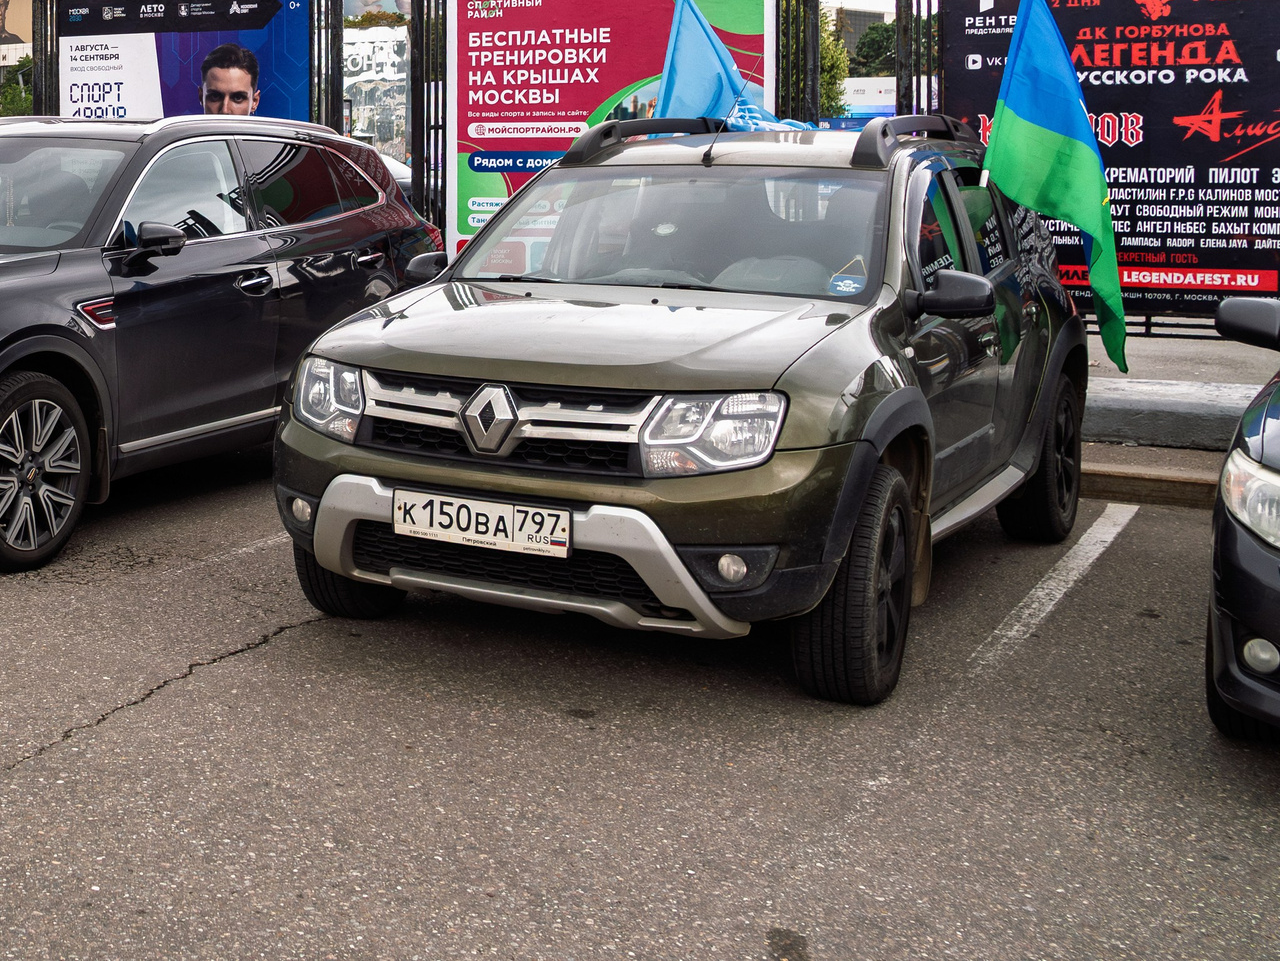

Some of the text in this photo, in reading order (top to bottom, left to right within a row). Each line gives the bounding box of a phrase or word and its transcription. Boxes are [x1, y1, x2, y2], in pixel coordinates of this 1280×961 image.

[140, 4, 165, 13] ЛЕТО
[289, 1, 300, 9] 0+
[468, 8, 503, 19] РАЙОН
[965, 15, 1017, 27] РЕН ТВ
[468, 27, 611, 48] БЕСПЛАТНЫЕ
[1076, 23, 1230, 40] ДК ГОРБУНОВА
[75, 44, 109, 52] АВГУСТА
[1070, 39, 1243, 67] ЛЕГЕНДА
[468, 47, 607, 66] ТРЕНИРОВКИ
[986, 57, 1002, 66] VK
[86, 64, 123, 72] СВОБОДНЫЙ
[468, 67, 599, 86] НА КРЫШАХ
[1185, 67, 1249, 84] РОКА
[70, 82, 123, 103] СПОРТ
[468, 88, 560, 105] МОСКВЫ
[488, 126, 581, 135] МОЙСПОРТРАЙОН.РФ
[474, 157, 513, 168] Рядом
[516, 158, 524, 167] с
[1104, 165, 1195, 184] КРЕМАТОРИЙ
[1209, 168, 1259, 184] ПИЛОТ
[1170, 189, 1195, 201] F.P.G
[1198, 189, 1252, 201] КАЛИНОВ
[1136, 203, 1204, 218] СВОБОДНЫЙ
[1206, 205, 1248, 218] РЕЖИМ
[1254, 206, 1280, 219] МОН
[1136, 221, 1171, 233] АНГЕЛ
[1211, 222, 1251, 235] БАХЫТ
[1120, 237, 1161, 247] ЛАМПАСЫ
[1166, 237, 1195, 248] RADOPI
[1200, 238, 1227, 248] ЕЛЕНА
[1228, 239, 1248, 249] JAYA
[1170, 253, 1199, 264] ГОСТЬ
[1123, 270, 1259, 287] LEGENDAFEST.RU
[1144, 292, 1173, 301] 107076,
[1184, 294, 1221, 302] МОСКВА,
[403, 499, 561, 539] К150ВА 797
[462, 537, 497, 547] Петровский
[527, 534, 550, 545] RUS
